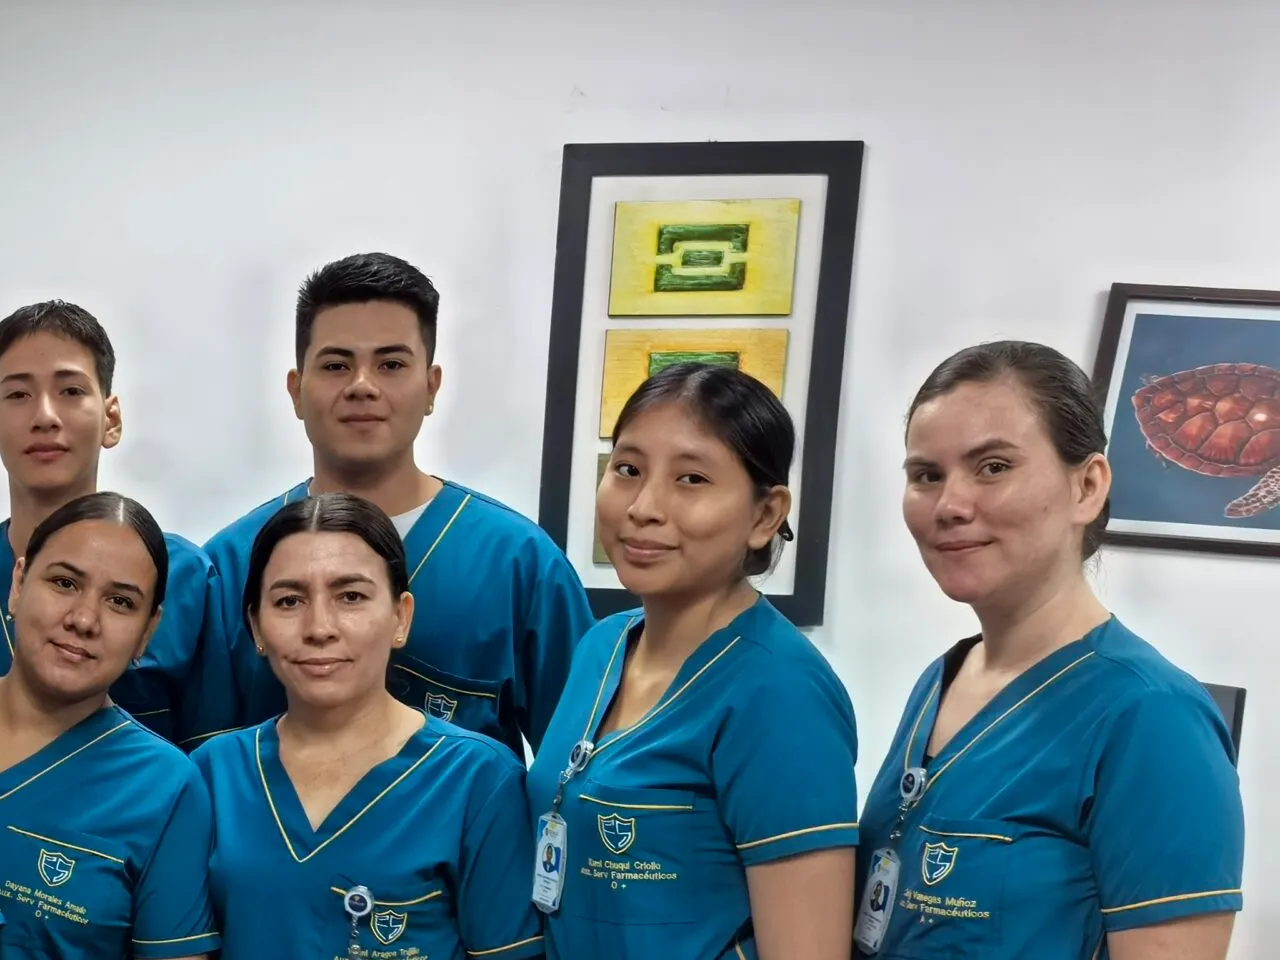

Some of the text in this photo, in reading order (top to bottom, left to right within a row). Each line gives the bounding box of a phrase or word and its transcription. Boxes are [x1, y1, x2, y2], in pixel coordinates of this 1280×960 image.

[610, 870, 677, 880] Farmacéuticos
[34, 888, 62, 906] Morales
[945, 897, 977, 908] Muñoz
[920, 904, 990, 918] Farmacéuticos
